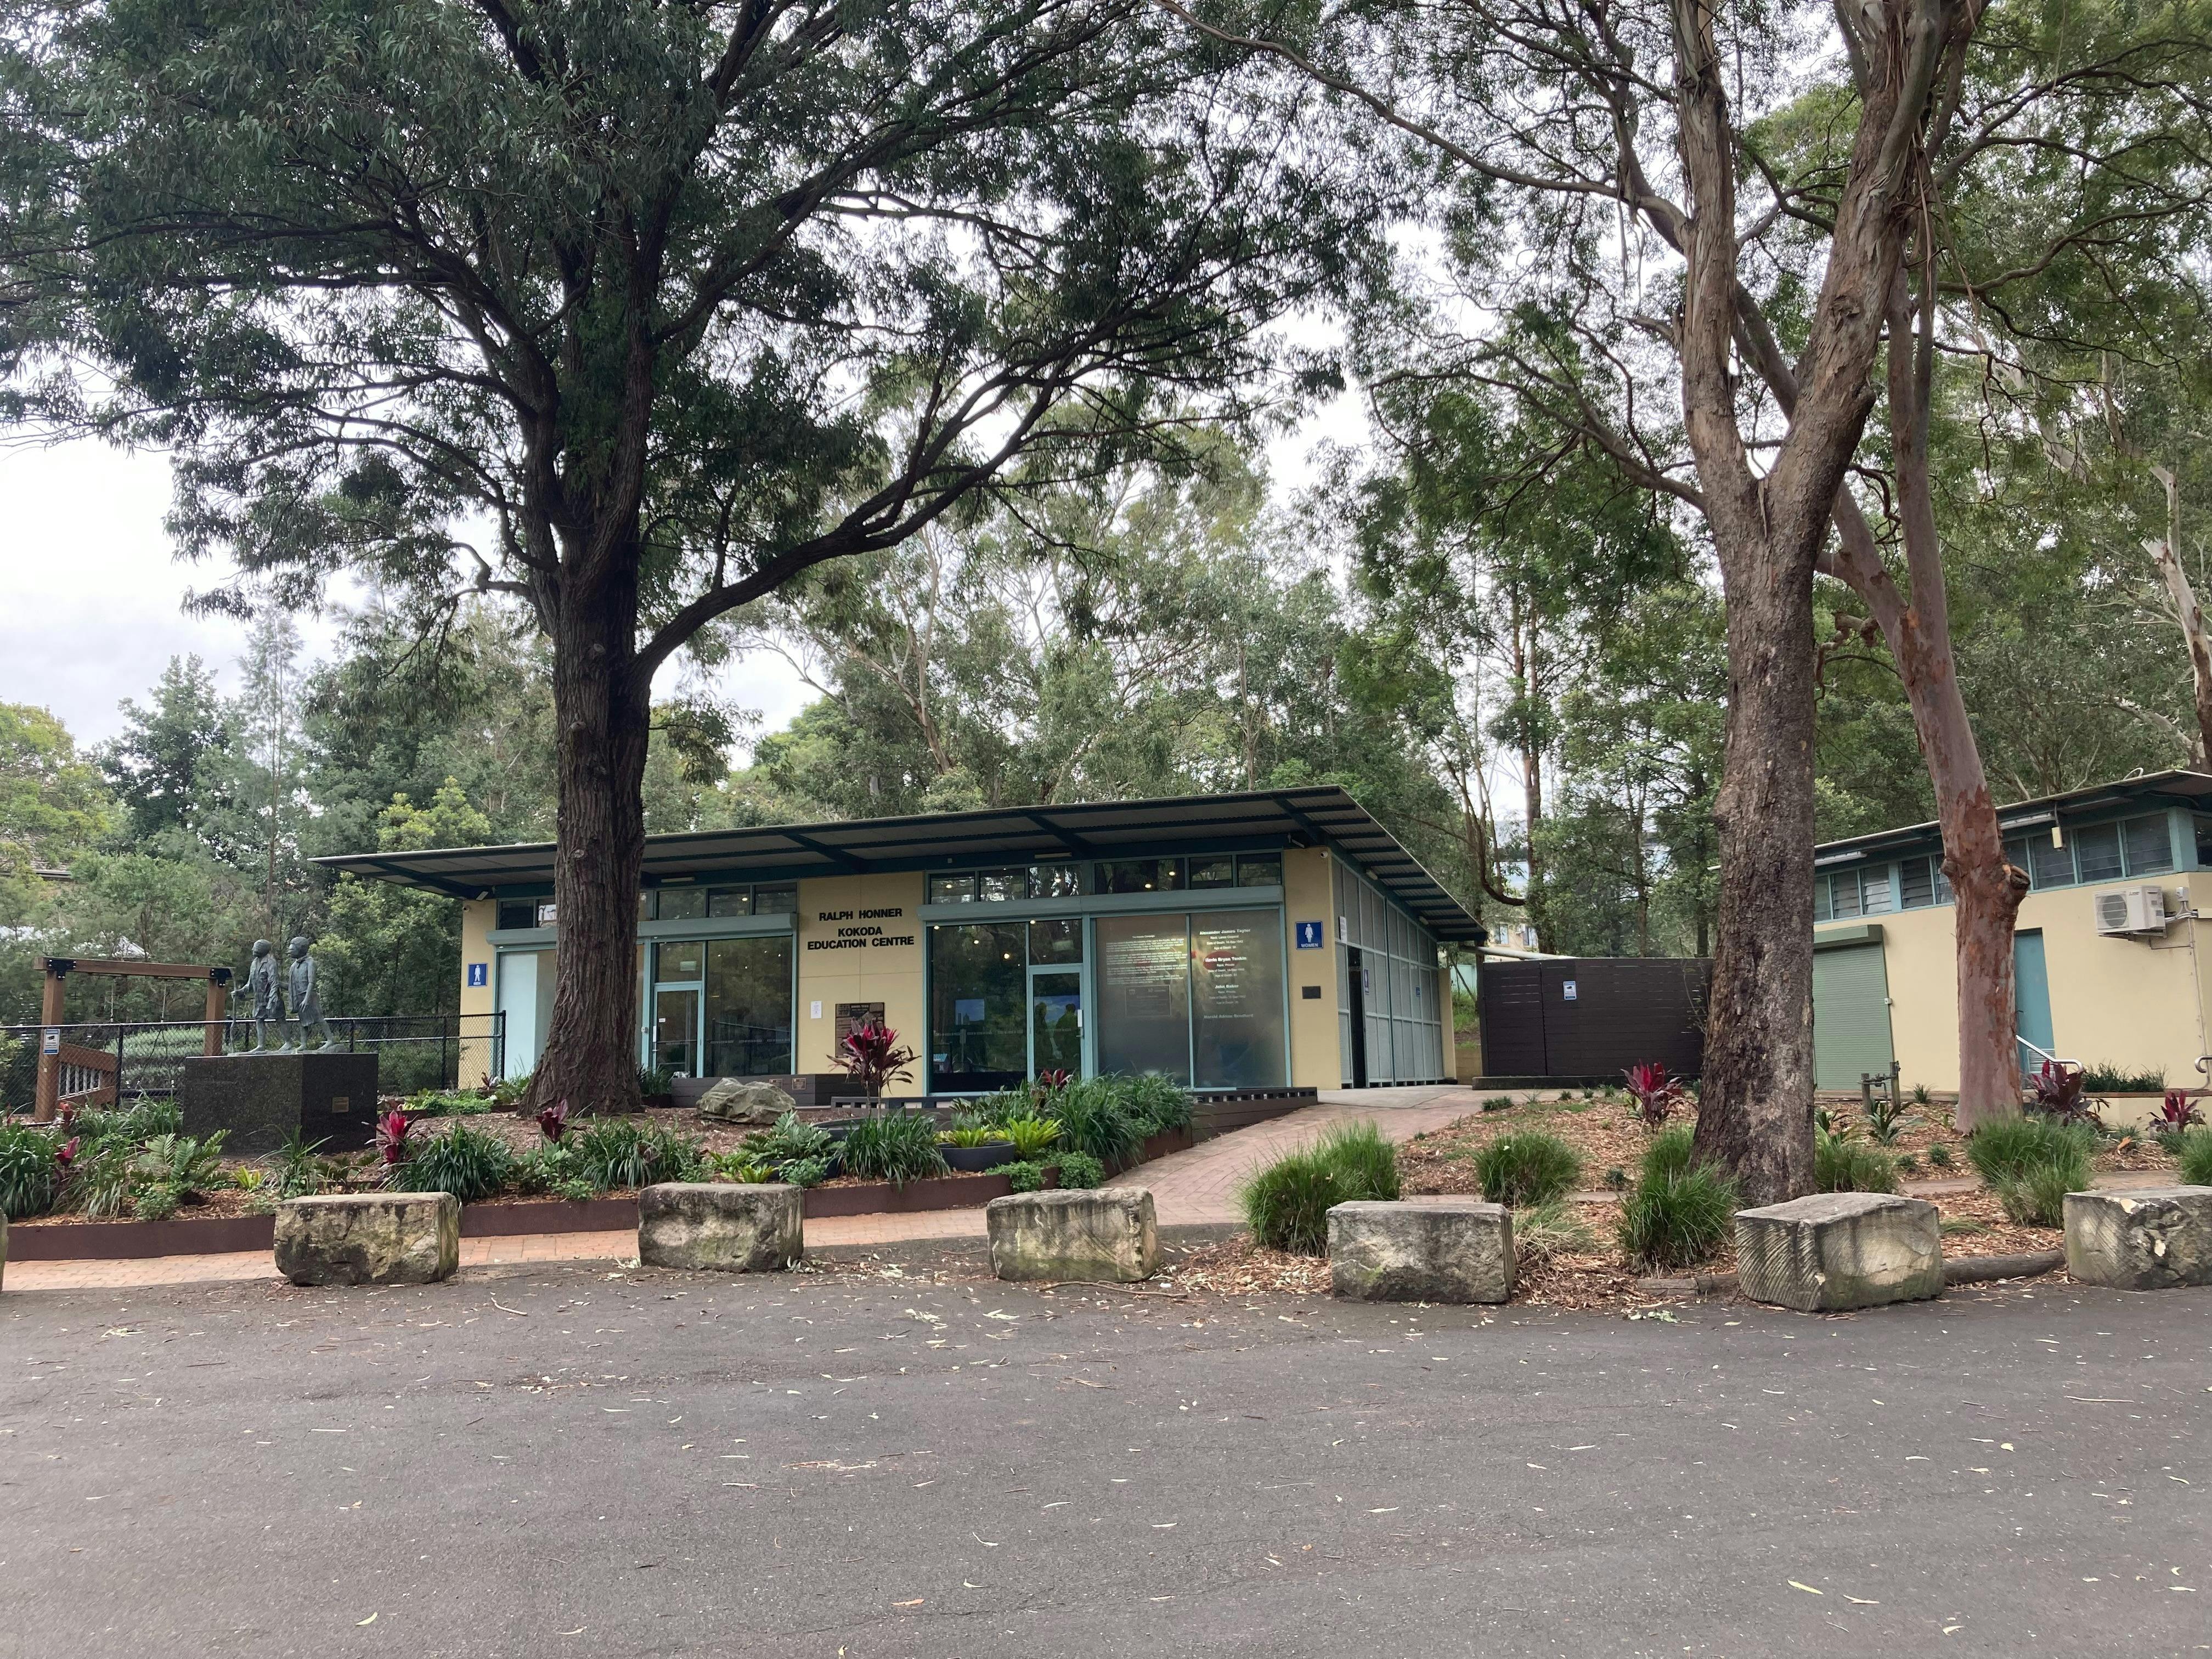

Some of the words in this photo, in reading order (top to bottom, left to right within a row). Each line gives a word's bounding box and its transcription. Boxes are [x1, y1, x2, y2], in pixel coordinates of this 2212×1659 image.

[819, 911, 853, 921] RALPH
[859, 908, 902, 919] HONNER
[838, 926, 882, 937] KOKODA
[808, 938, 866, 950] EDUCATION
[872, 936, 915, 947] CENTRE
